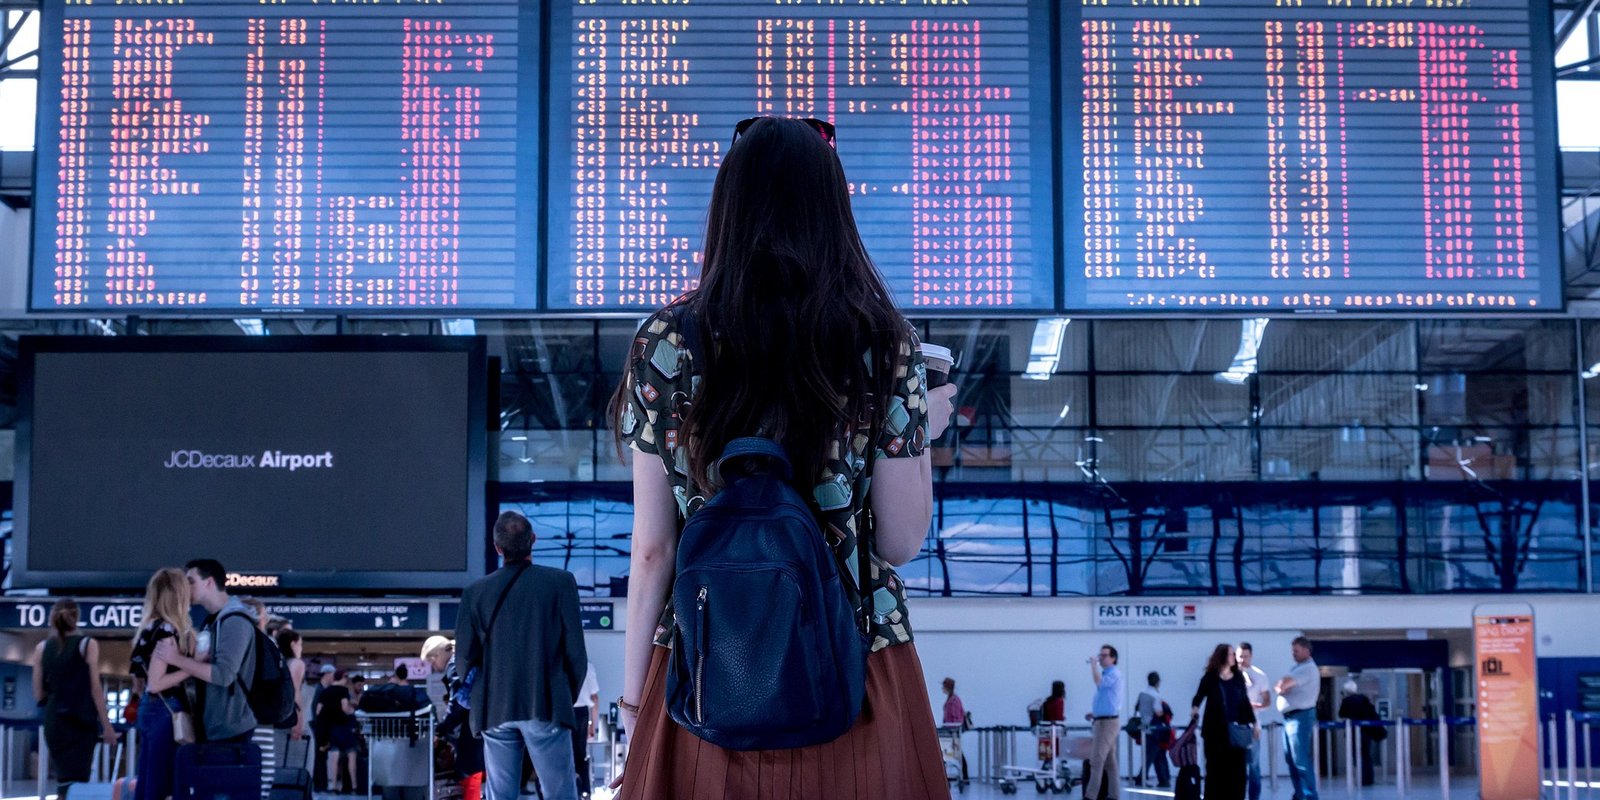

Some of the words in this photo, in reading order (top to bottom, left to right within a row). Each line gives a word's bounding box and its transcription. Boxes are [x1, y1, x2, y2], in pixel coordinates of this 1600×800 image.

[164, 450, 255, 468] JCDecaux
[259, 450, 333, 471] Airport
[16, 604, 45, 627] TO
[273, 605, 290, 614] YOUR
[291, 605, 323, 614] PASSPORT
[323, 605, 337, 614] AND
[338, 605, 370, 614] BOARDING
[1099, 605, 1130, 617] FAST
[1135, 605, 1177, 617] TRACK
